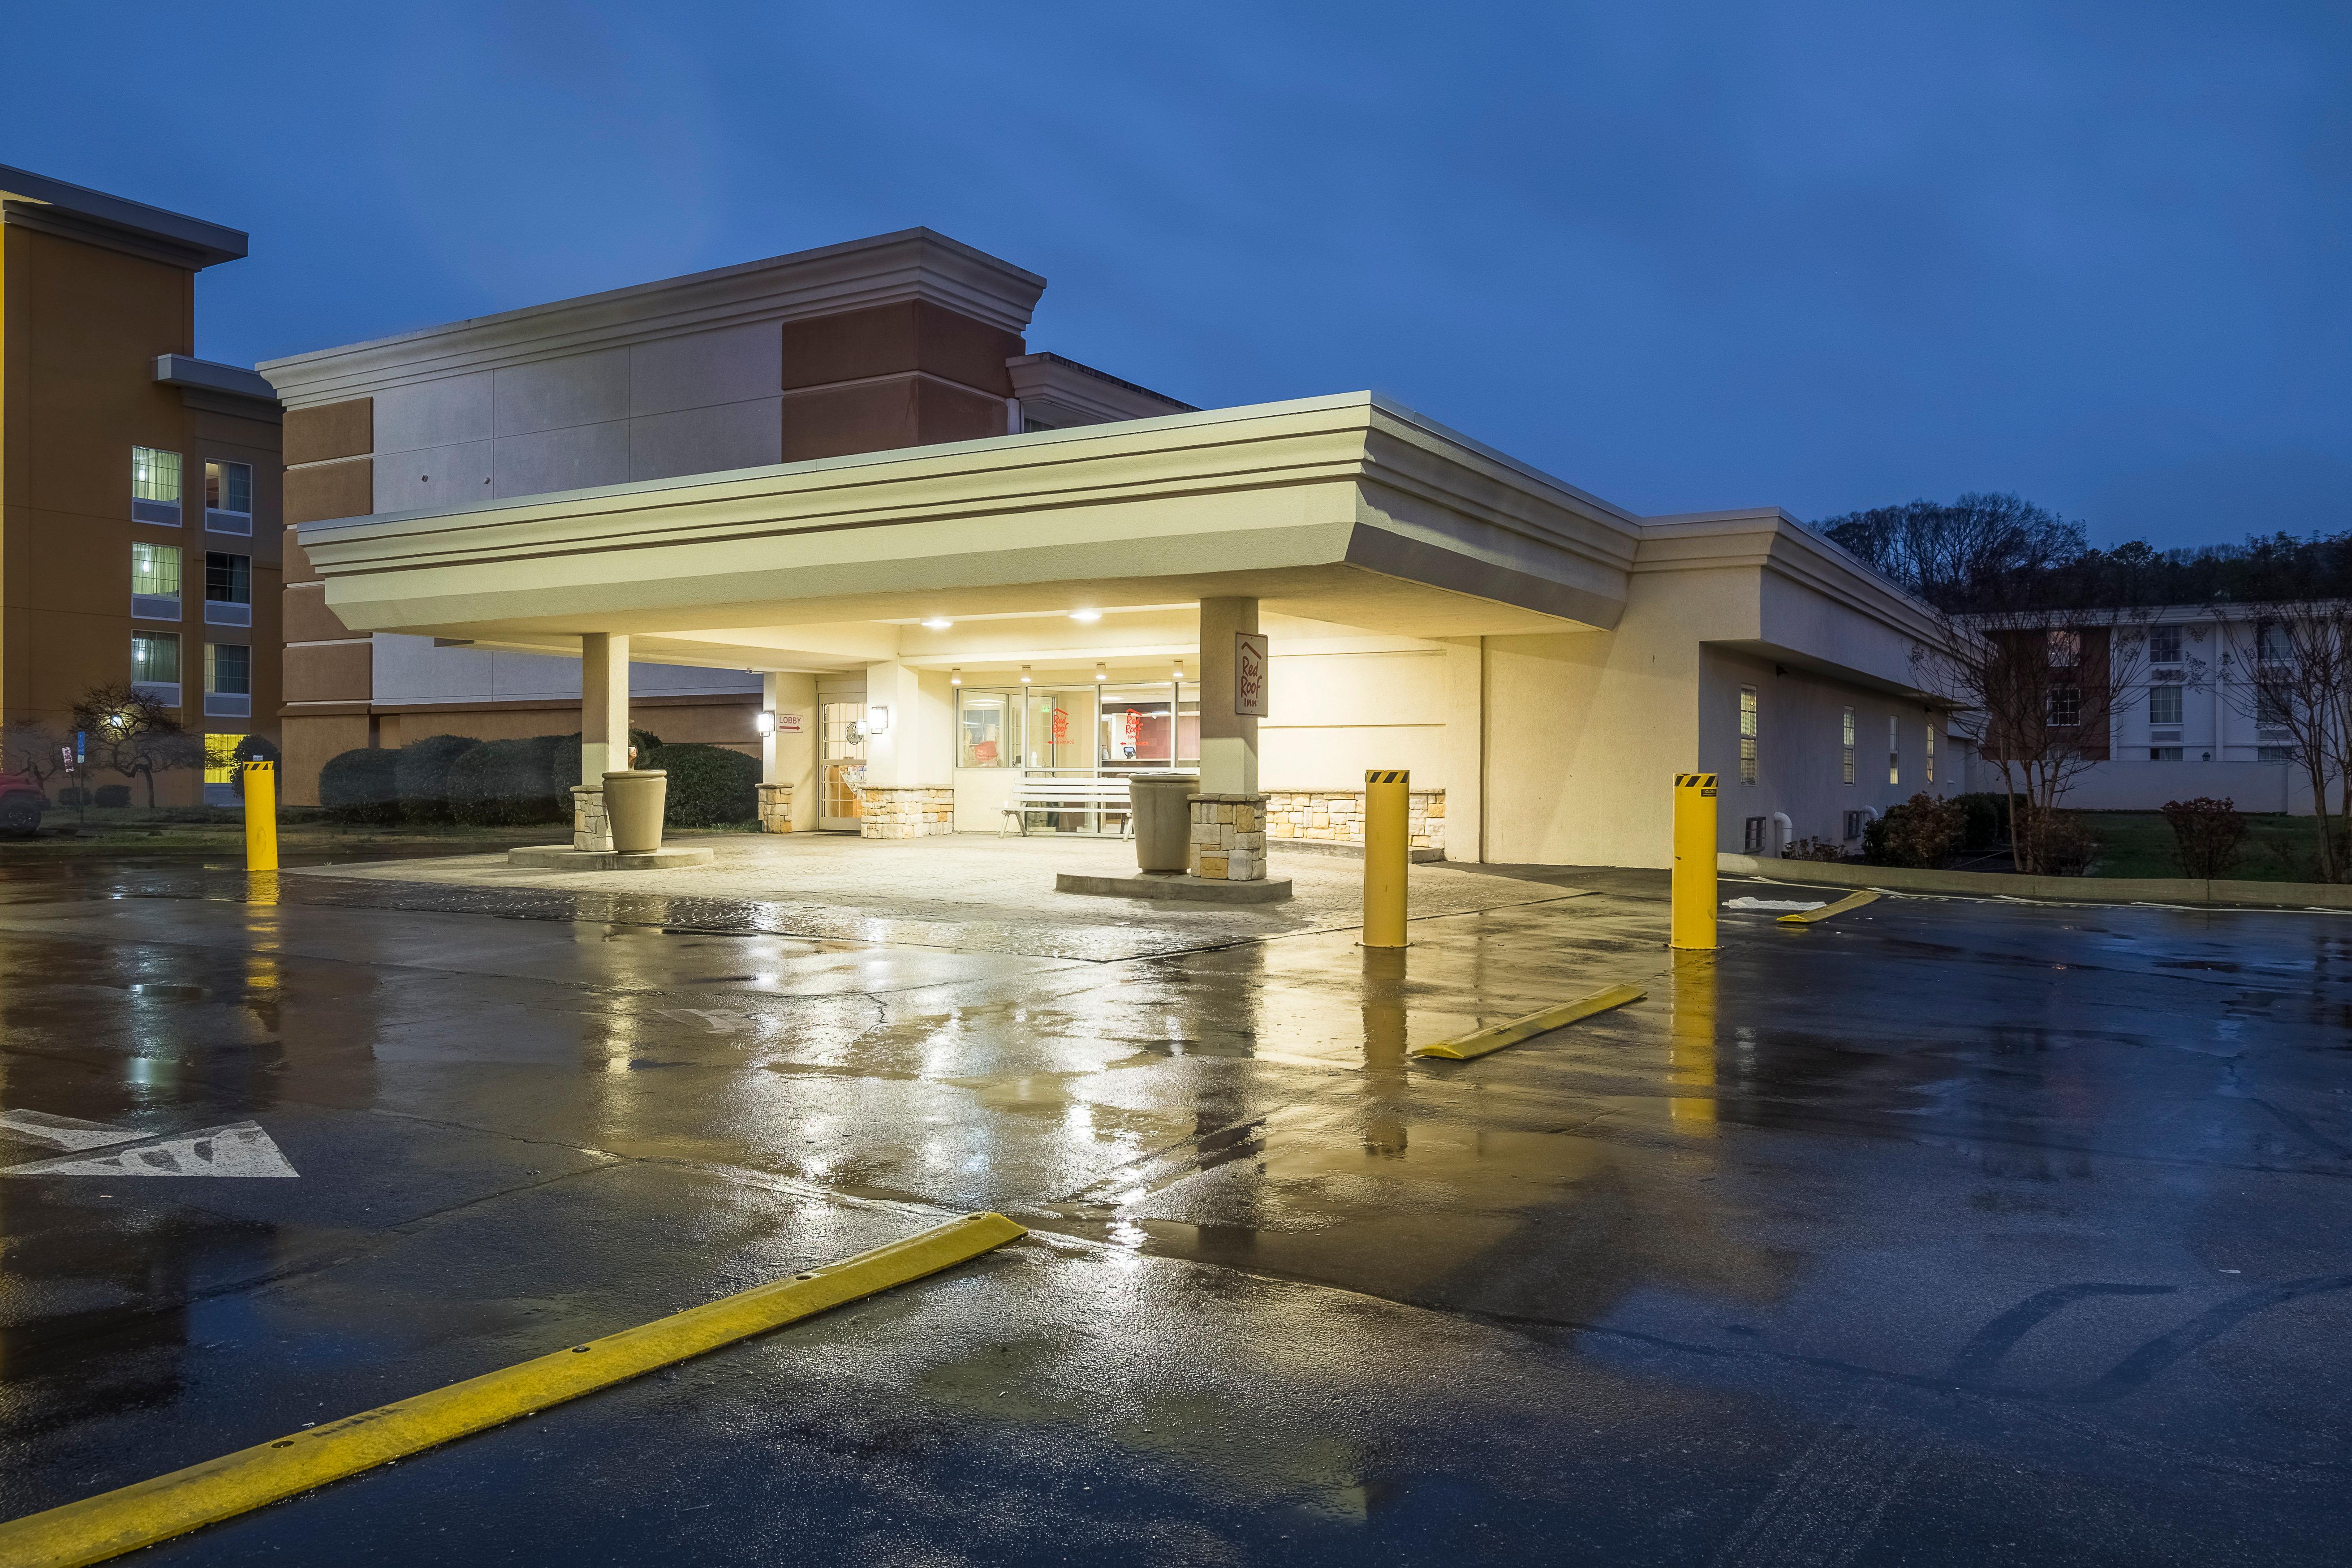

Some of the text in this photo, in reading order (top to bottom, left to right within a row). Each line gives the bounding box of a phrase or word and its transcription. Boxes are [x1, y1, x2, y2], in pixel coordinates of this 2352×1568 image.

[1243, 656, 1258, 677] Red
[1241, 675, 1262, 699] Roof
[1244, 698, 1257, 707] Inn
[1054, 715, 1066, 724] Red
[1127, 715, 1141, 725] Red
[1052, 723, 1069, 734] Roof
[1126, 723, 1143, 735] Roof
